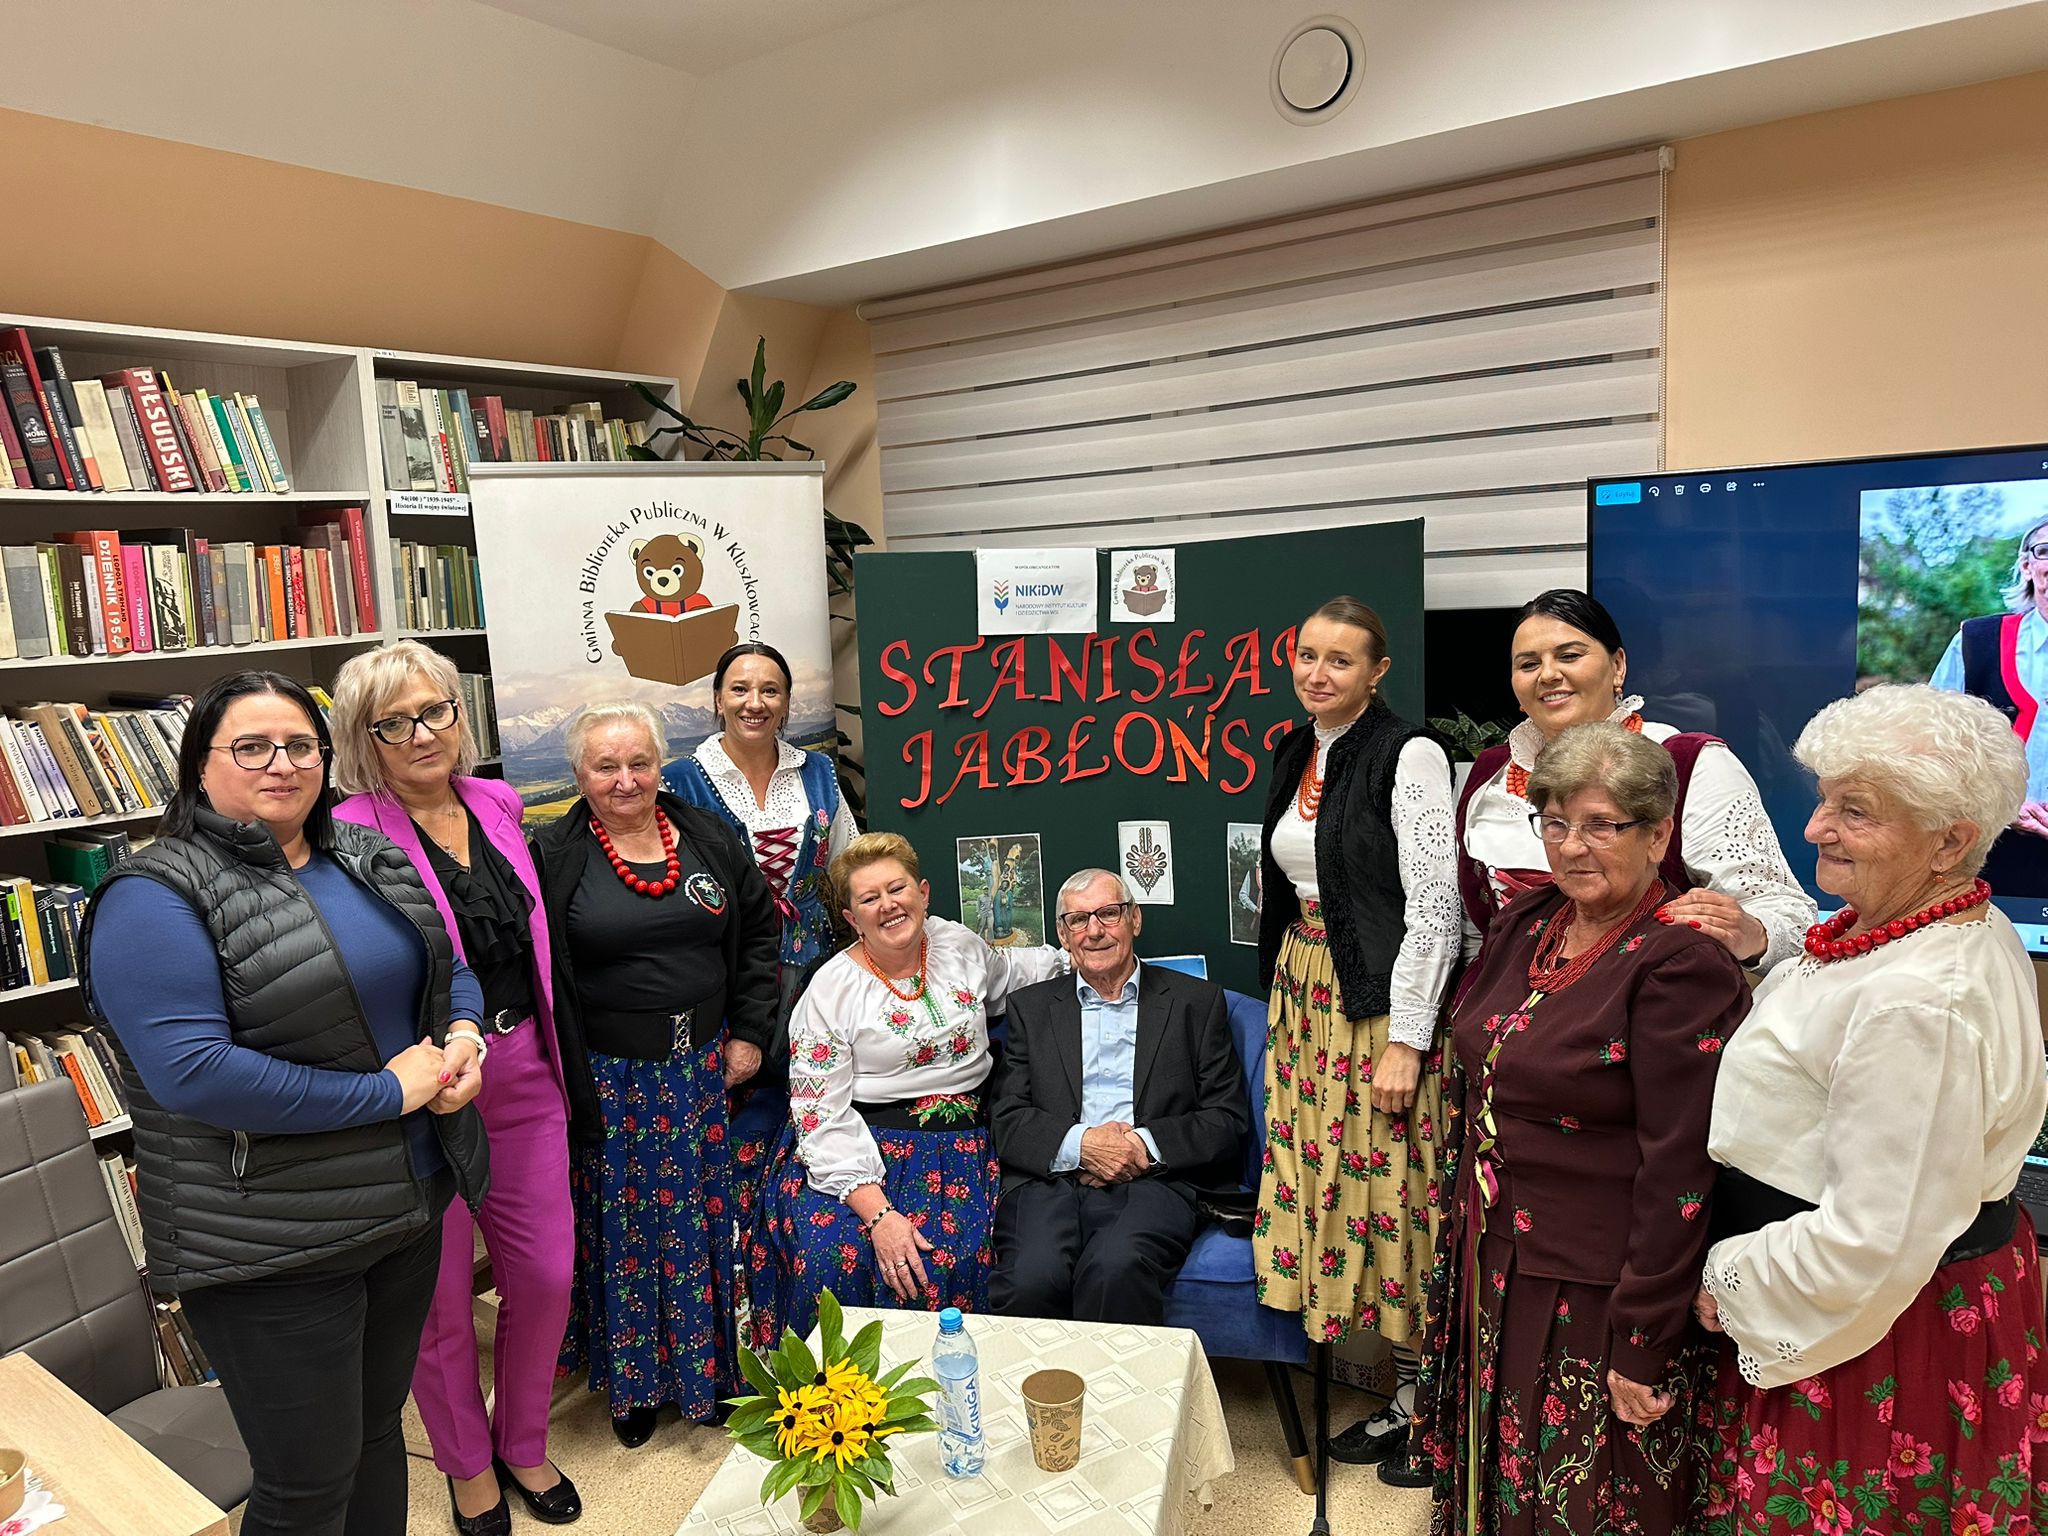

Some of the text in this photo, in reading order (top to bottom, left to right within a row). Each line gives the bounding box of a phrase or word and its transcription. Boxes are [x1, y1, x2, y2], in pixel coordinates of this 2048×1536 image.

[25, 430, 48, 438] NOBEL
[133, 370, 191, 489] PIŁSUDSKI
[206, 414, 223, 450] REYMONT
[579, 521, 630, 594] Biblioteka
[630, 501, 707, 530] Publiczna
[98, 540, 118, 606] DZIENNIK
[113, 554, 127, 622] LEOPOLD TYRMAND
[1015, 584, 1064, 597] NIKiDW
[132, 561, 146, 636] LEOPOLD TYRMAND
[287, 587, 296, 628] WIESENTHAL
[8, 741, 22, 765] PAPAM
[18, 764, 36, 798] HABEMUS
[116, 1168, 138, 1227] HISTORIA WĘGIER
